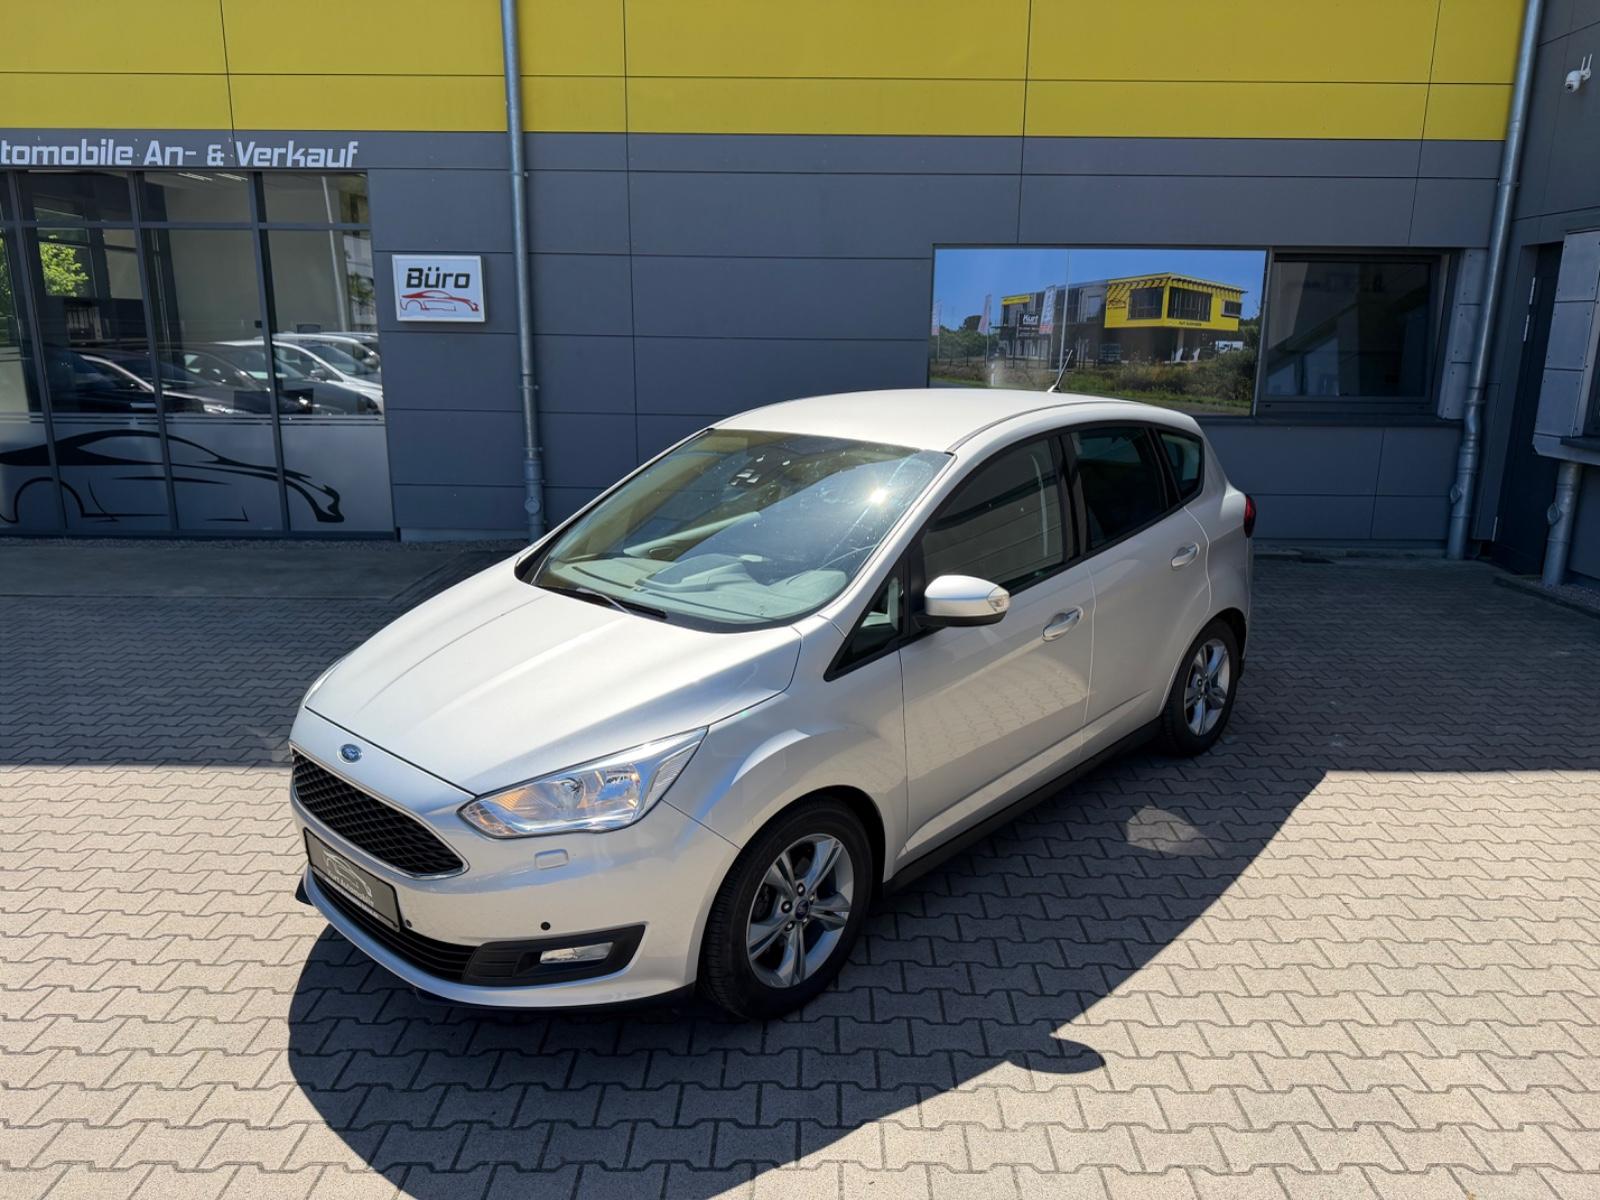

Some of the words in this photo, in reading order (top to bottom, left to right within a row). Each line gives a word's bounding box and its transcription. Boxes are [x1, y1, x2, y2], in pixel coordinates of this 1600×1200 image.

[1, 139, 133, 166] tomobile
[143, 140, 196, 167] An-
[207, 144, 225, 167] &
[236, 140, 359, 168] Verkauf
[406, 266, 471, 289] Büro
